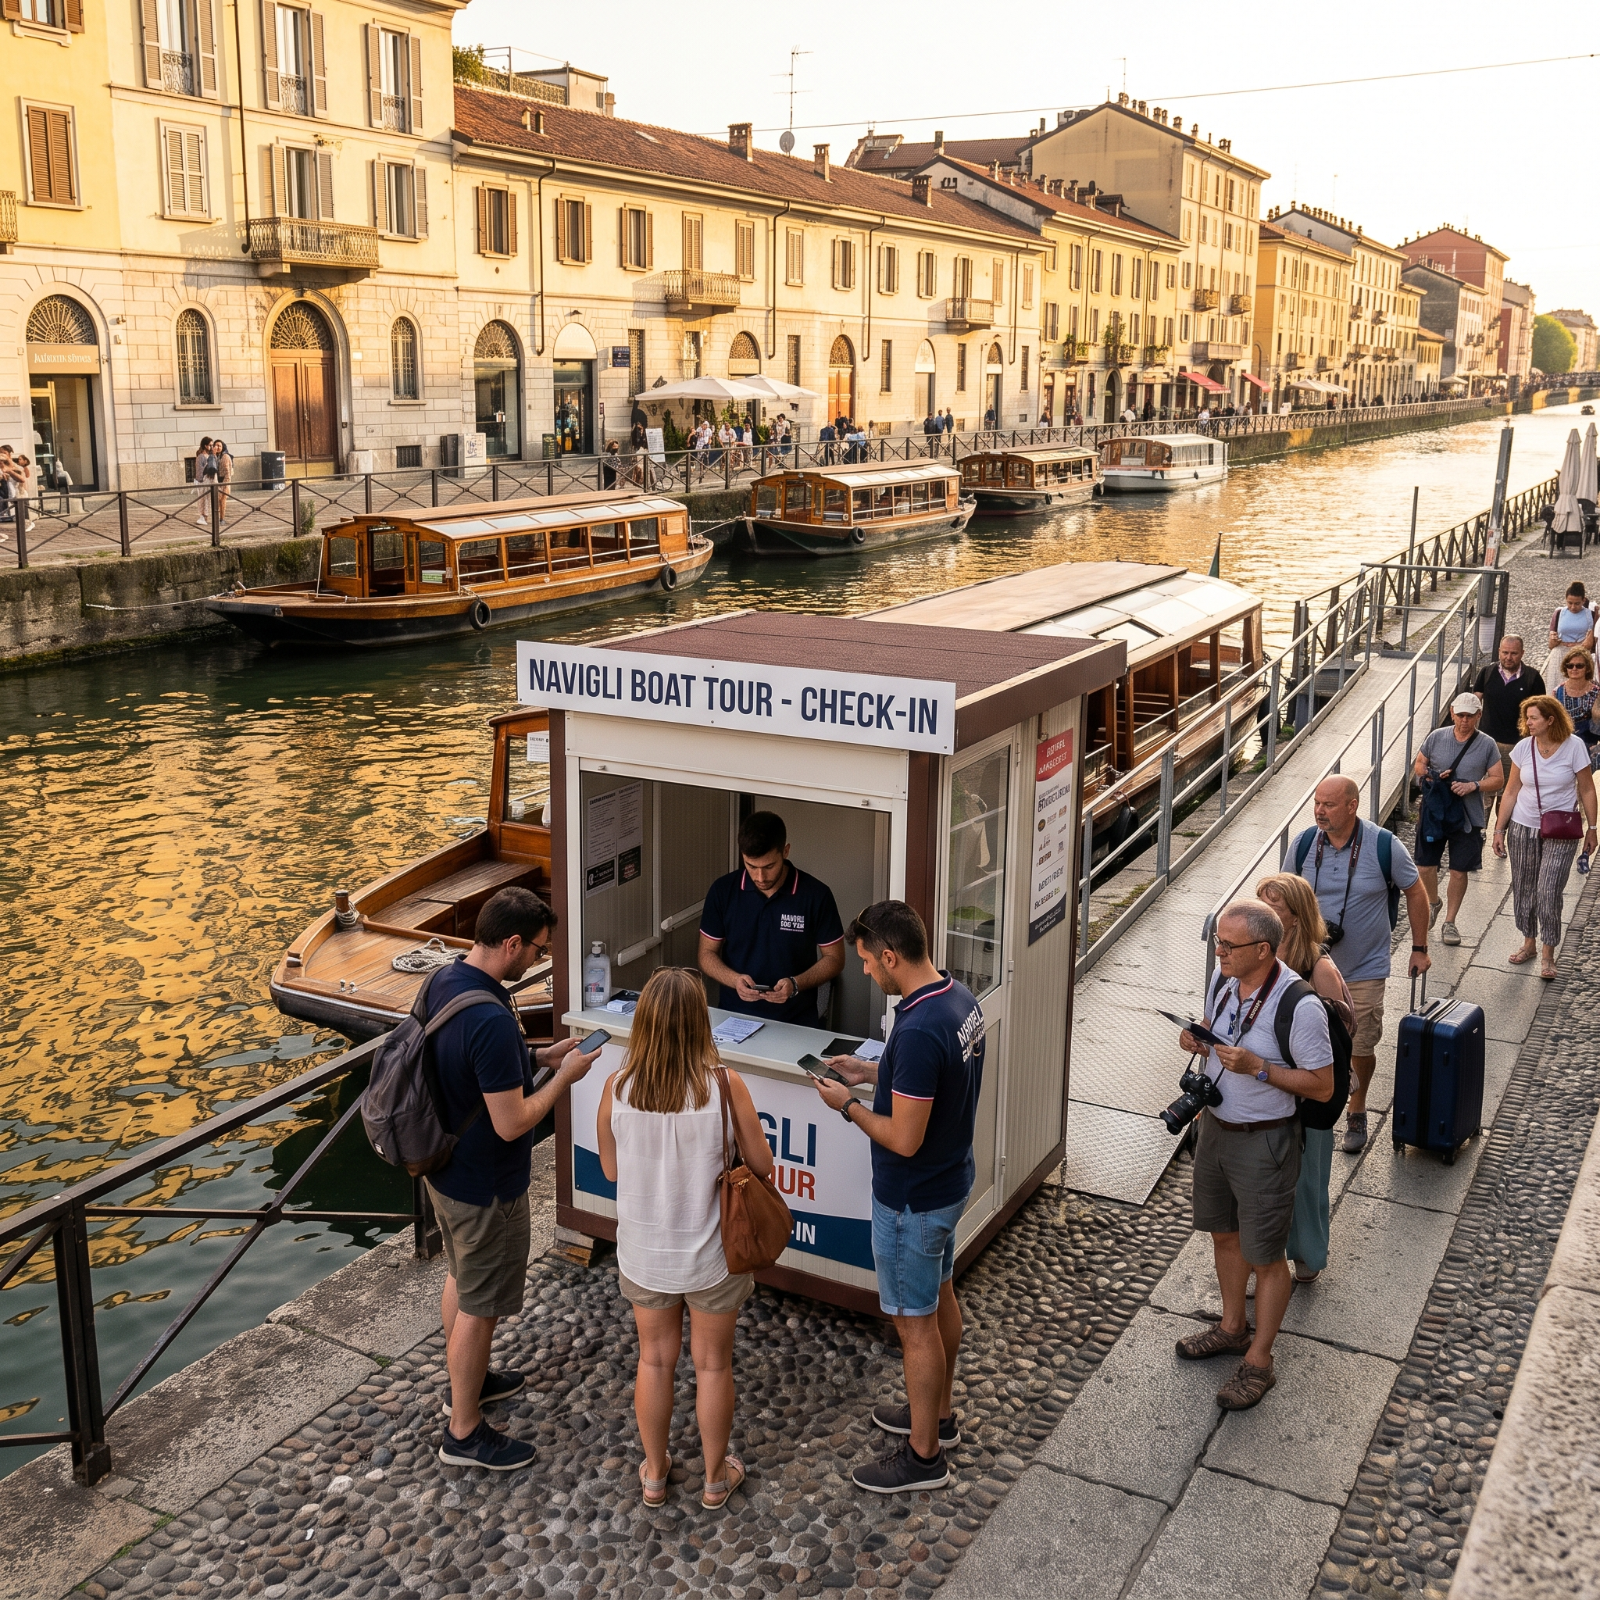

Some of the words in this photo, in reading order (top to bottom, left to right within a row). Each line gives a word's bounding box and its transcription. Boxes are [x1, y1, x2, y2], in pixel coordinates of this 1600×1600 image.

[529, 658, 622, 700] NAVIGLI
[631, 669, 696, 708] BOAT
[703, 676, 773, 717] TOUR
[781, 698, 792, 706] -
[801, 686, 938, 735] CHECK-IN
